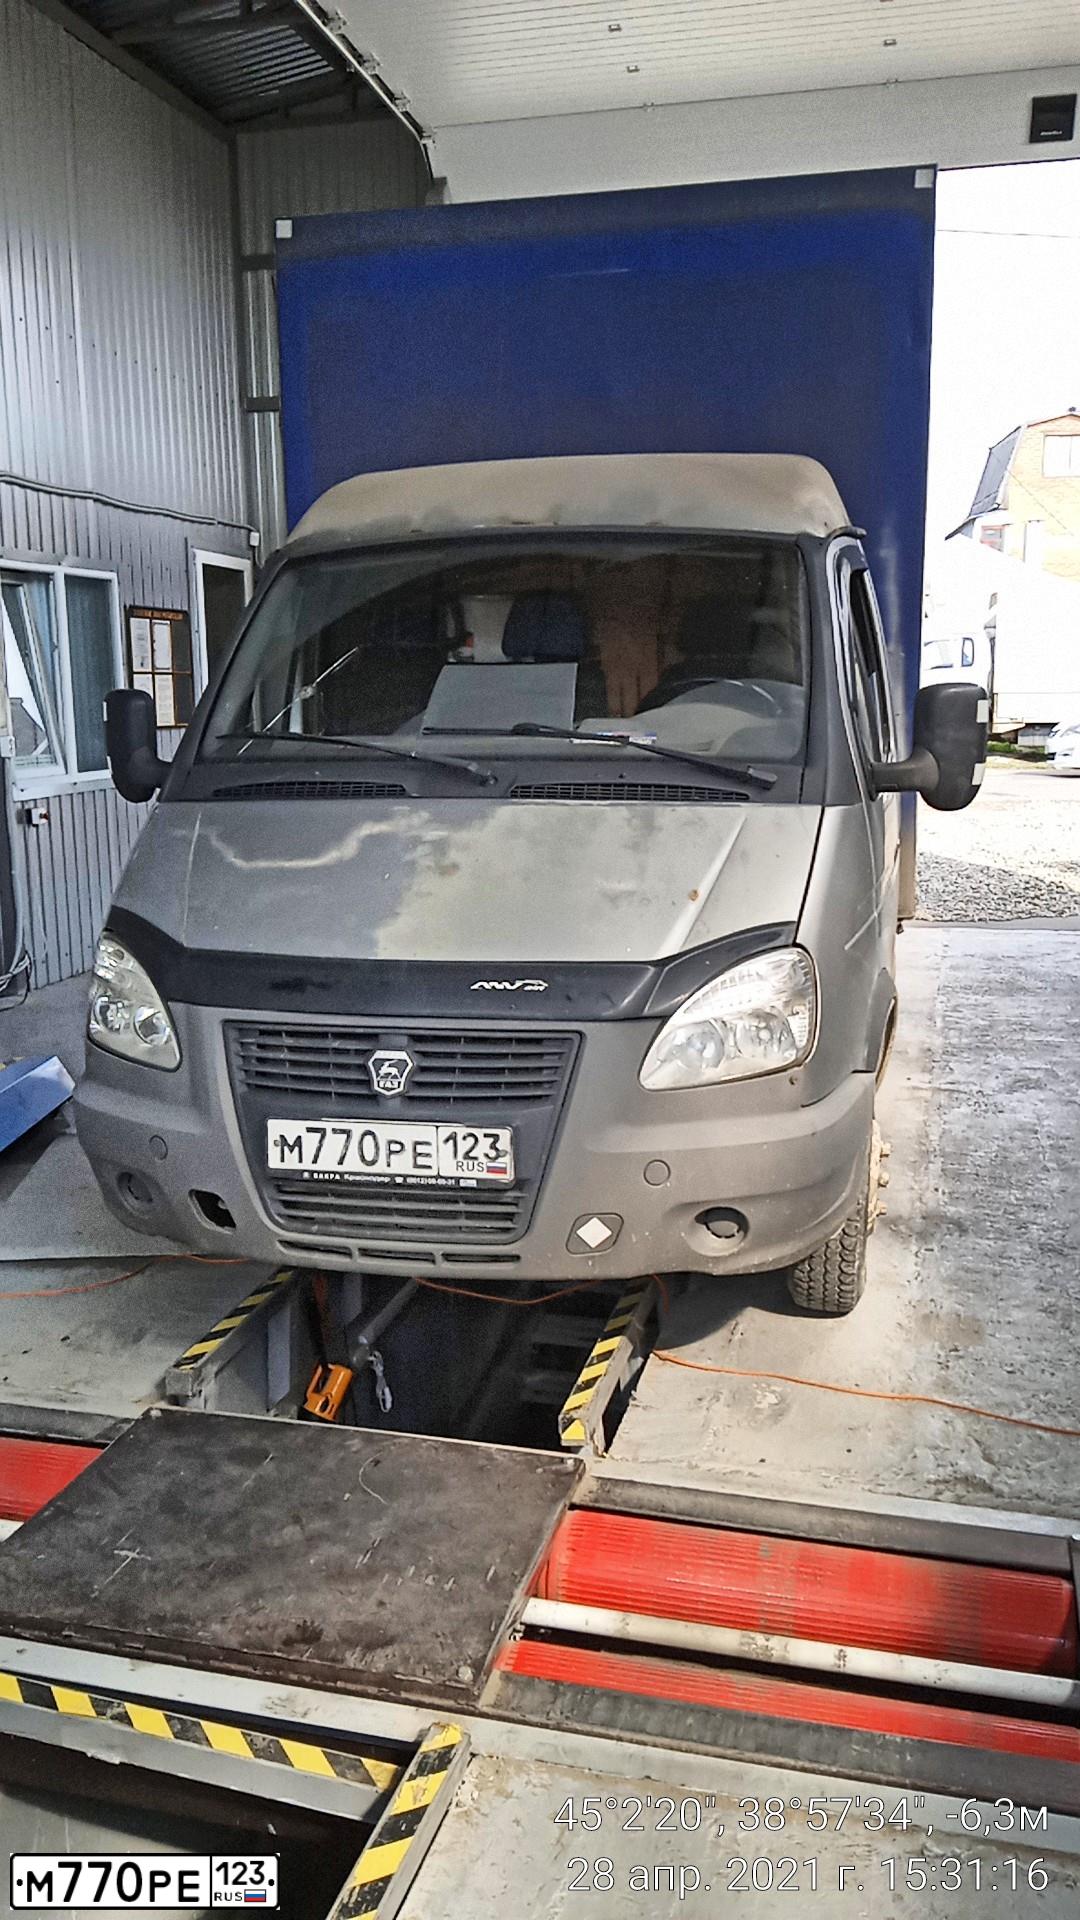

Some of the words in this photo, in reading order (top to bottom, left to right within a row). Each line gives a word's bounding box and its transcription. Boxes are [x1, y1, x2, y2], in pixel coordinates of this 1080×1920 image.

[279, 1126, 433, 1170] М770РЕ
[442, 1131, 503, 1161] 123
[455, 1161, 485, 1174] RUS
